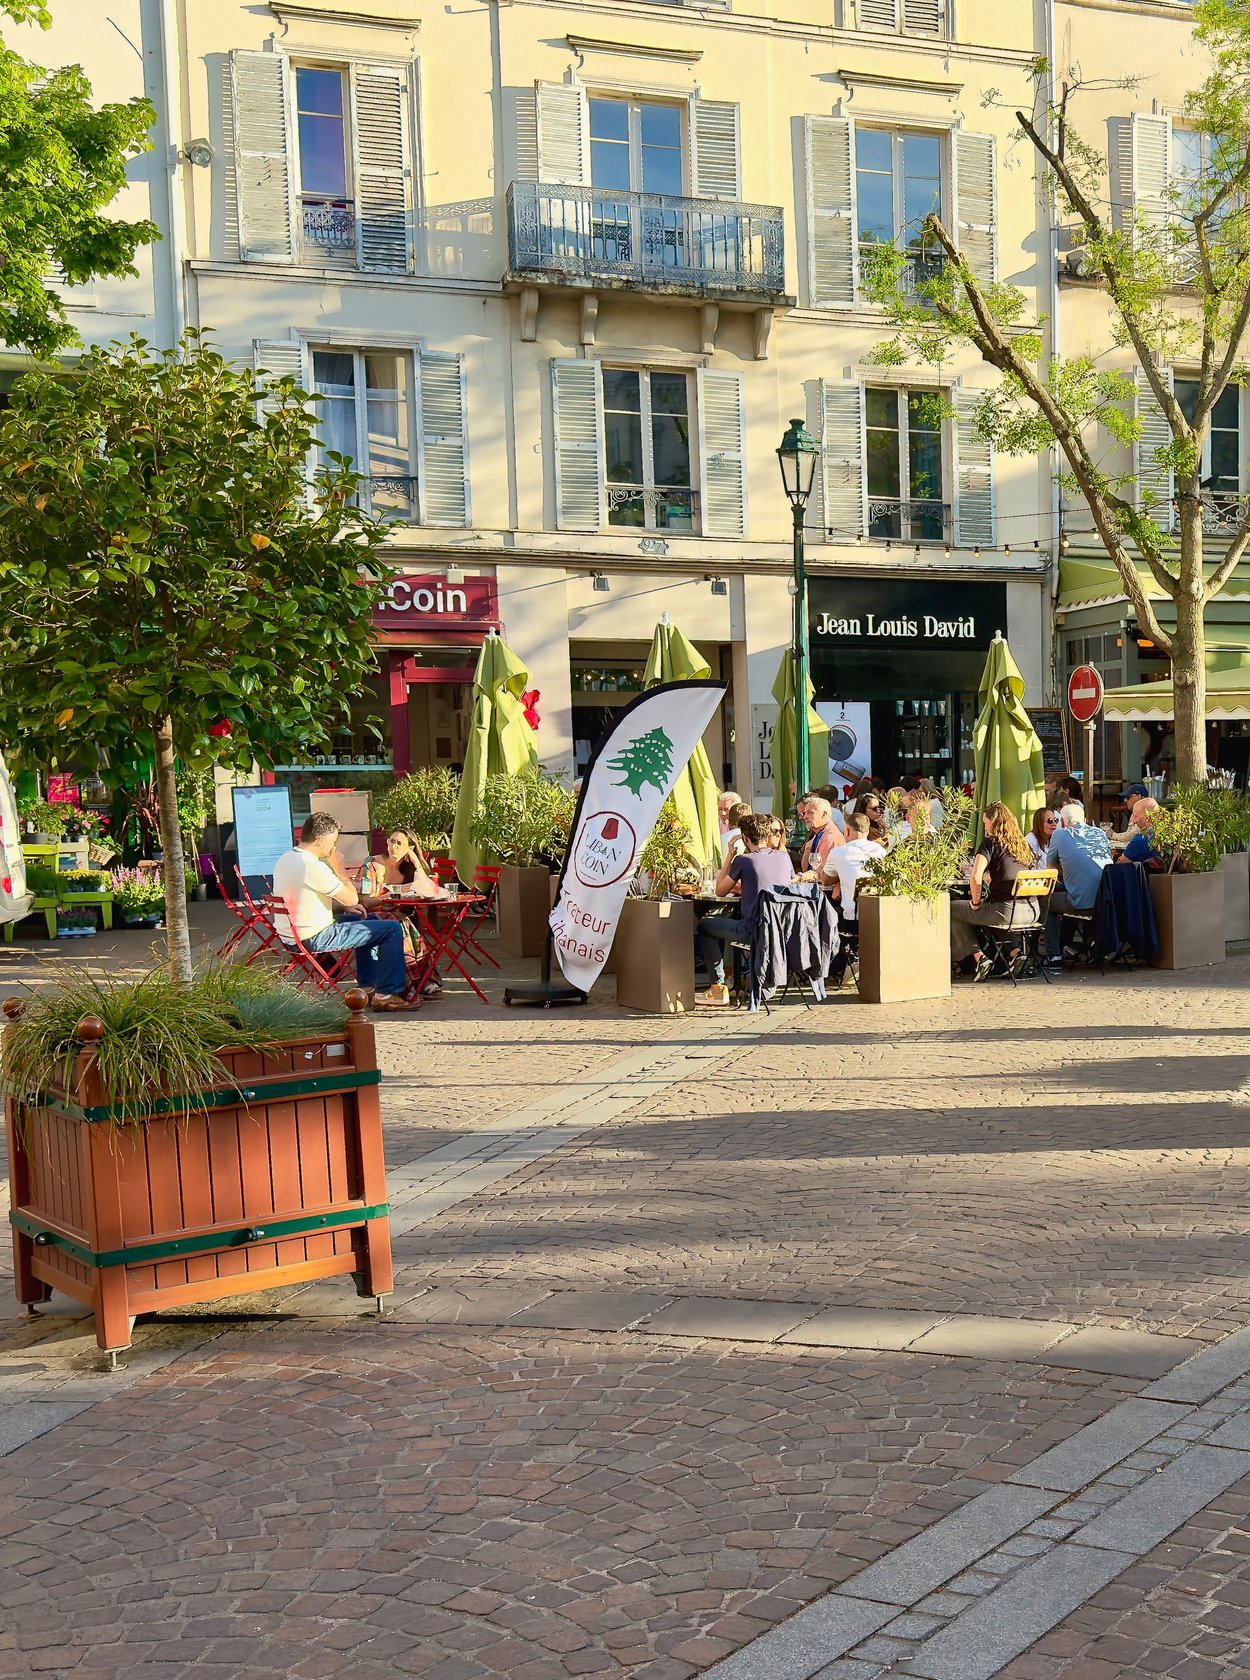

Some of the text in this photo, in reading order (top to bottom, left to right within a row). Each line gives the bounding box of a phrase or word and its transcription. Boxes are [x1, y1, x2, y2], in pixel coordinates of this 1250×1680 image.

[645, 540, 662, 551] 27
[378, 581, 467, 613] Coin
[816, 612, 976, 638] Jean Louis David
